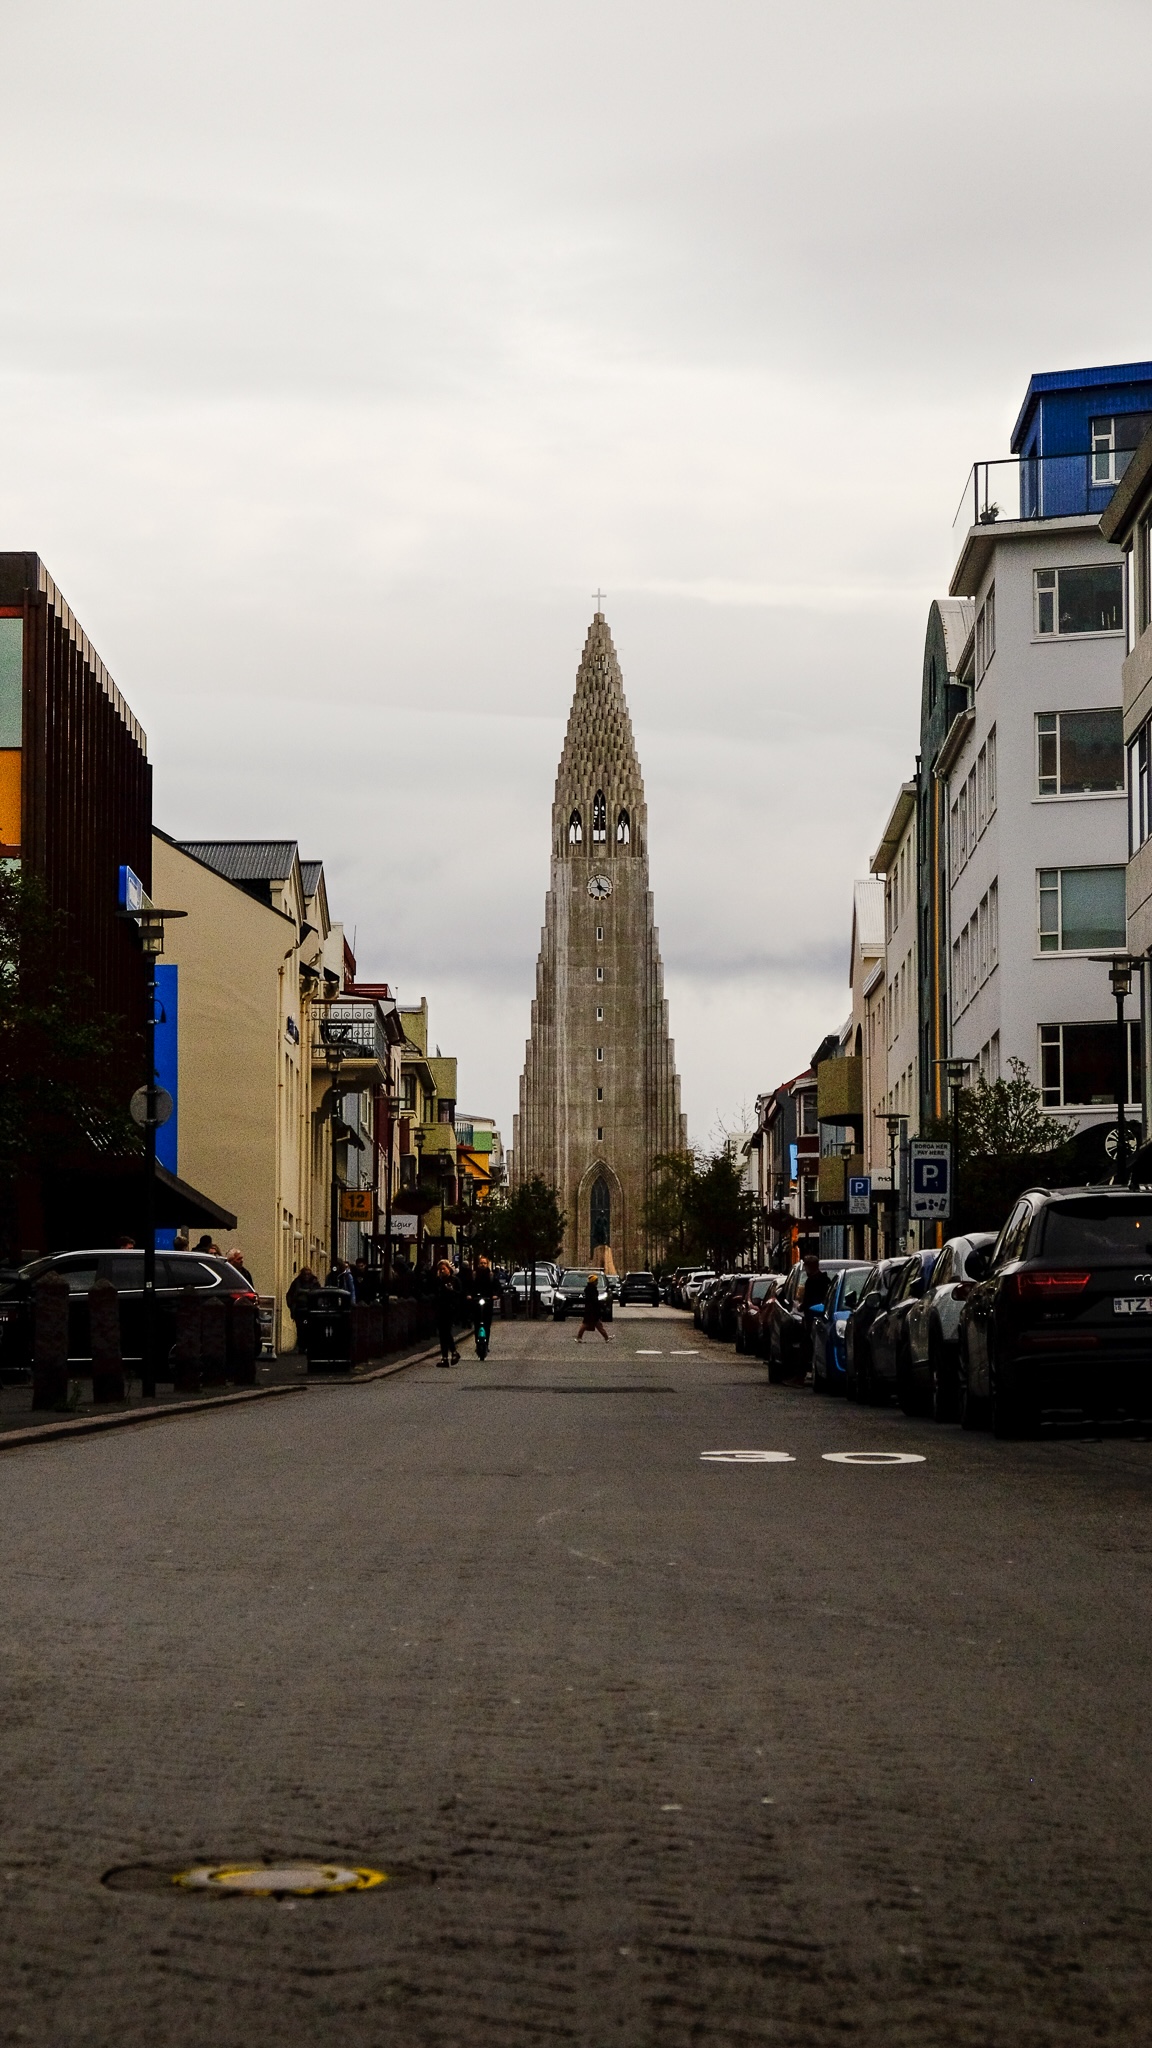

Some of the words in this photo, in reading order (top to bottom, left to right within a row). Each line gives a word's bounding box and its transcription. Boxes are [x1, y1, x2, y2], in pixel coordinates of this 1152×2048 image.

[922, 1164, 939, 1187] P
[855, 1181, 864, 1193] P
[348, 1194, 365, 1208] 12
